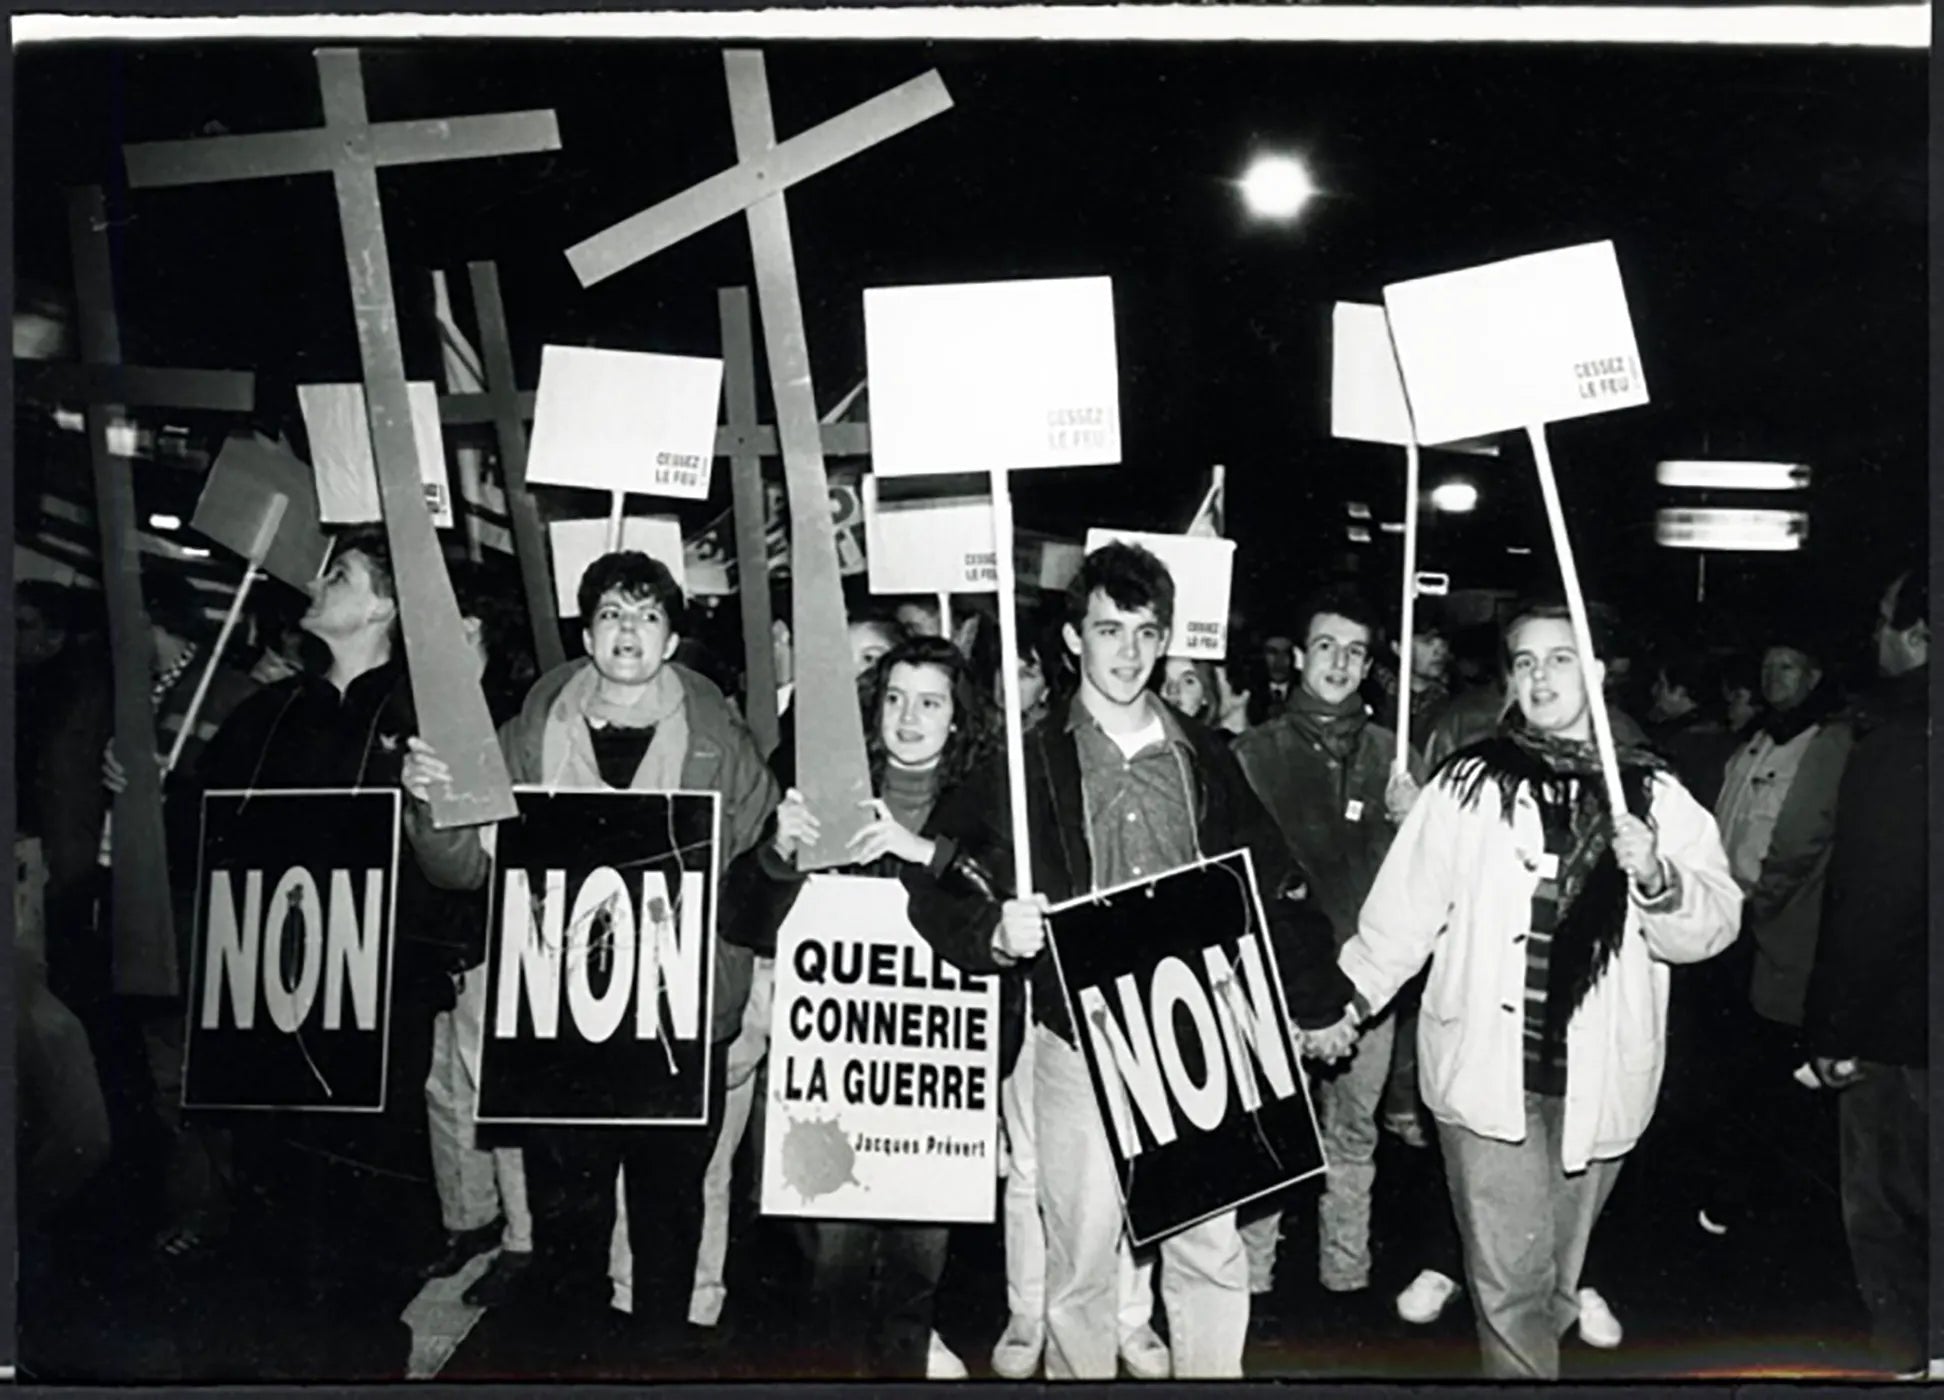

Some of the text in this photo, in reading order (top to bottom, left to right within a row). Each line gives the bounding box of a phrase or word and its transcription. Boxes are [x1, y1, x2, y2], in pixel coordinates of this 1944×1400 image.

[1574, 356, 1625, 379] CESSEZ
[1579, 377, 1629, 399] LE FEU
[655, 468, 669, 483] LE
[964, 552, 997, 566] CESSE
[202, 866, 383, 1033] NON
[495, 866, 704, 1043] NON
[790, 995, 987, 1051] CONNERIE
[1079, 933, 1297, 1159] NON
[785, 1056, 986, 1110] LA GUERRE
[855, 1132, 986, 1158] Jacques Prévert
